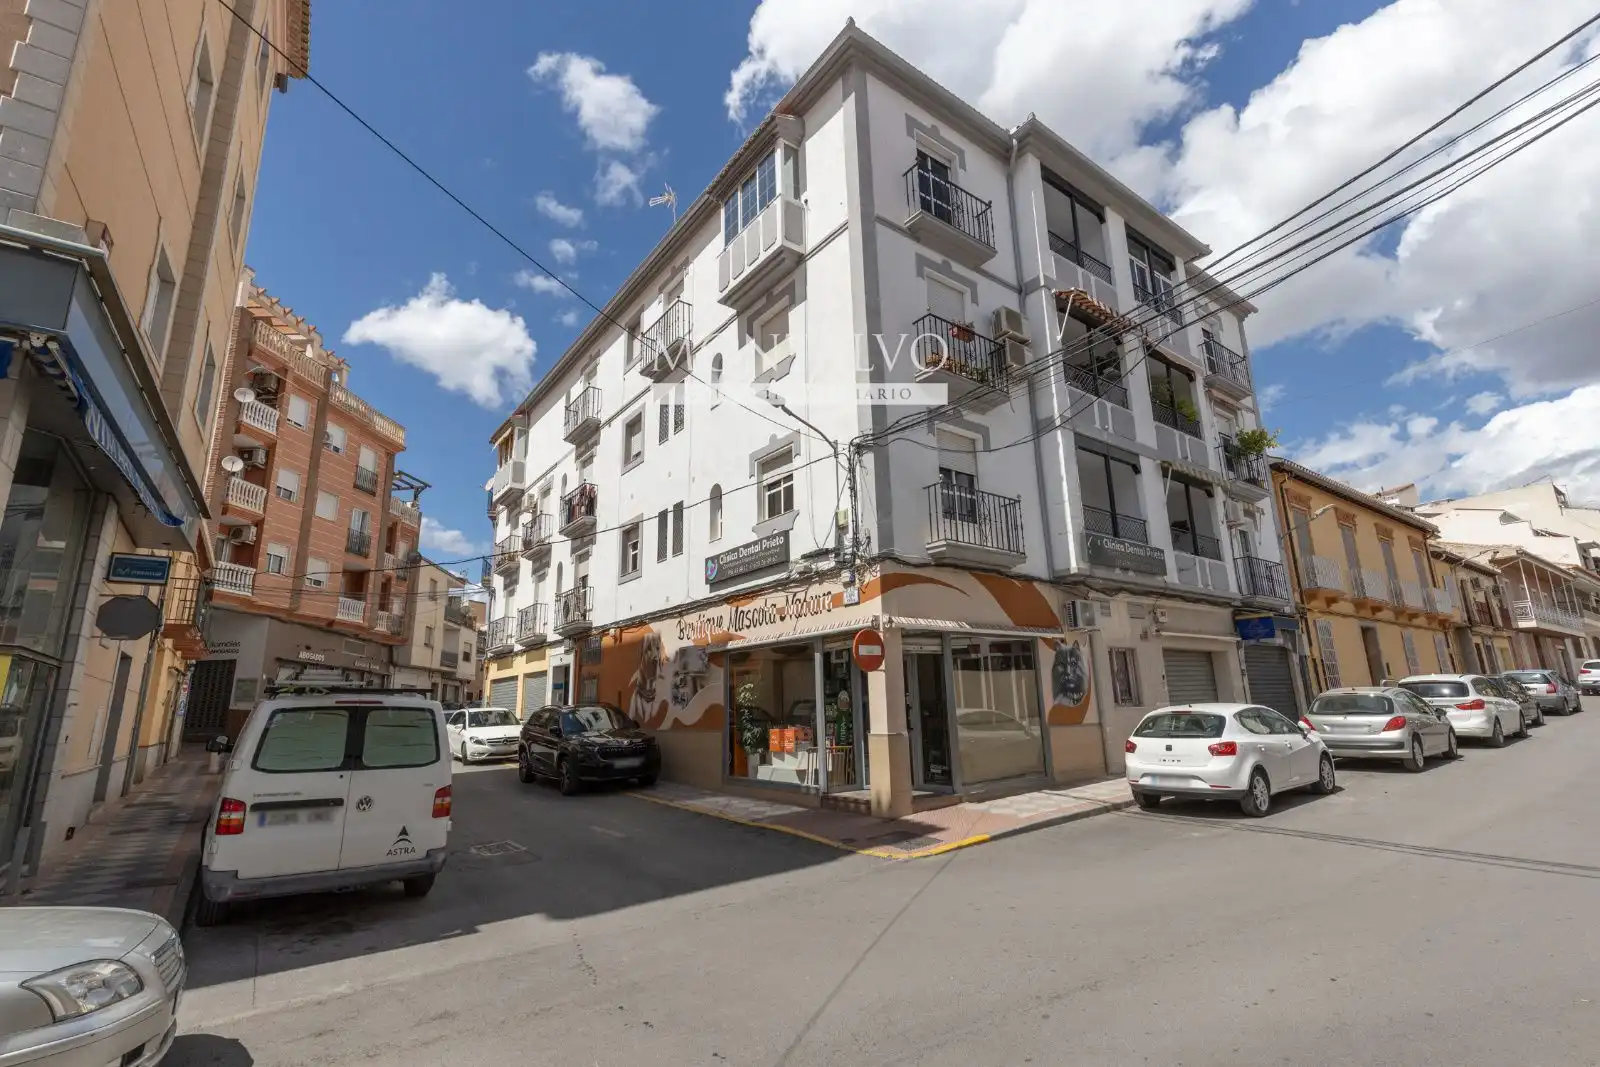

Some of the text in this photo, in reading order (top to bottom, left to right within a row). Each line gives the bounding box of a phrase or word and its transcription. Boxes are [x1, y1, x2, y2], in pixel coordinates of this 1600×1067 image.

[739, 541, 761, 558] Dental
[762, 535, 784, 550] Prieto
[727, 598, 777, 633] Mascota
[298, 650, 325, 662] ABOGADOS
[386, 846, 416, 857] ASTRA
